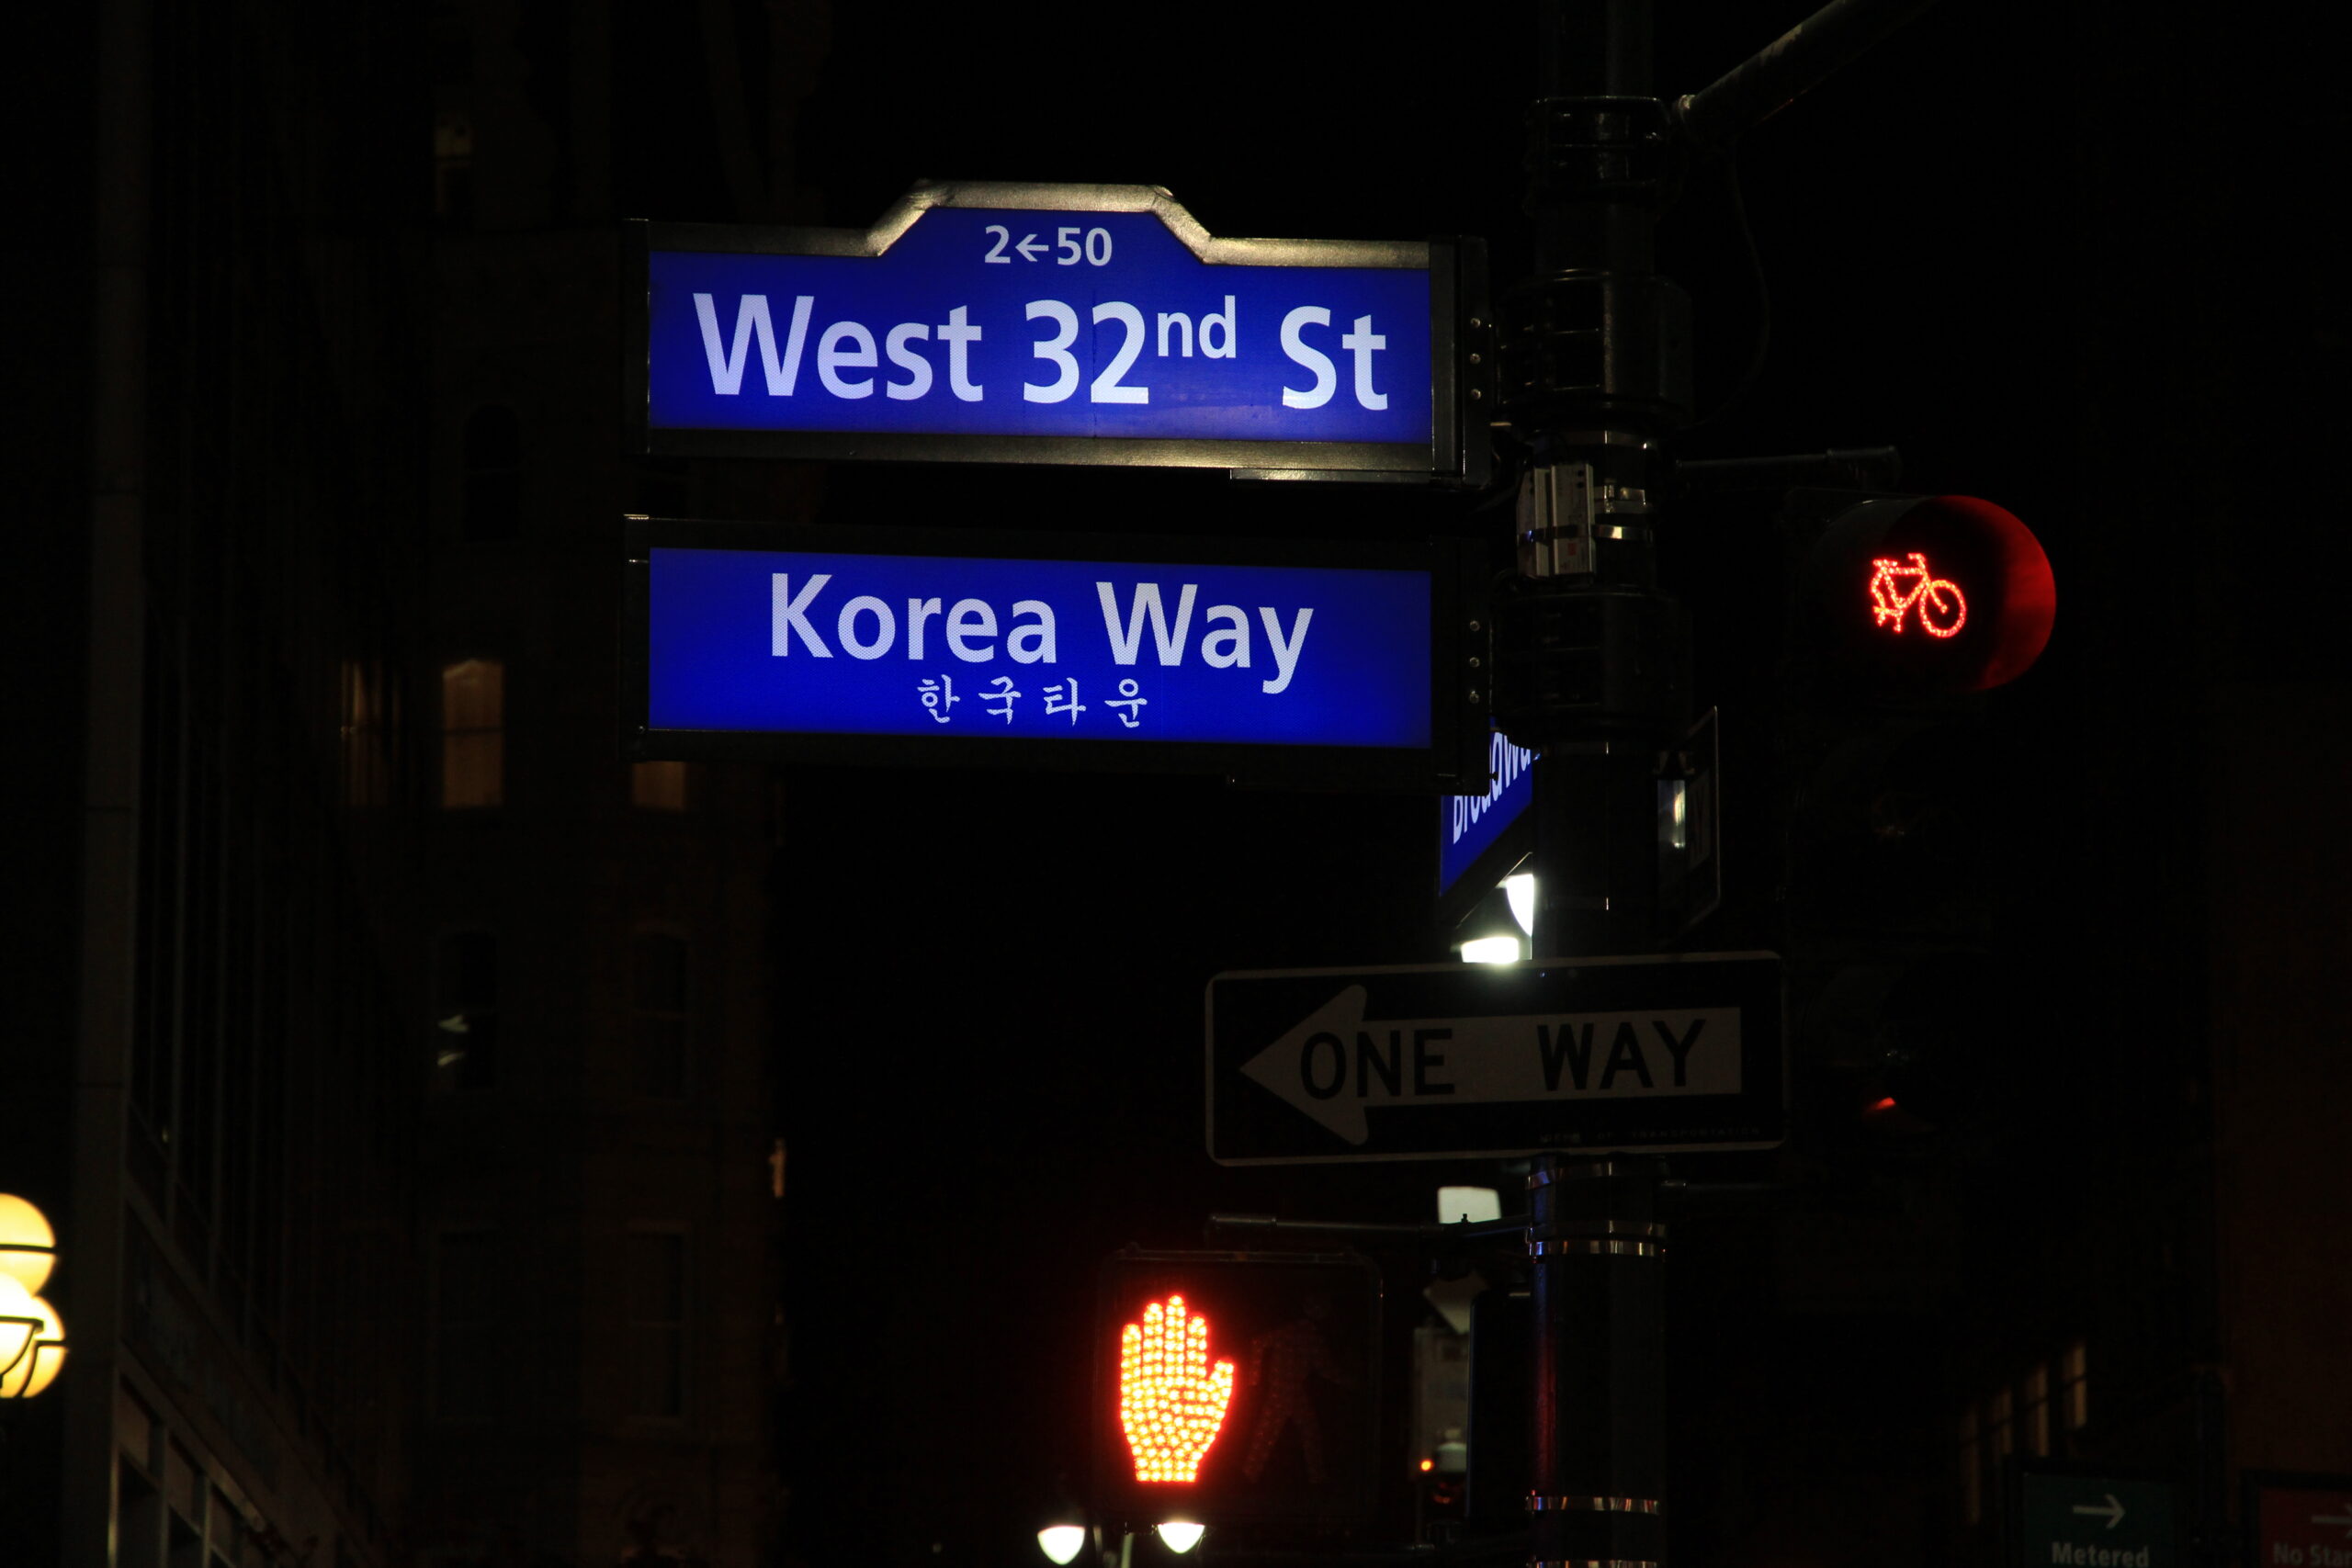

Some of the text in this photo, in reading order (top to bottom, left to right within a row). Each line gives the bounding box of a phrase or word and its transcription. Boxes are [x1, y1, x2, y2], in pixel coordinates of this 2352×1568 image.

[984, 224, 1114, 266] 2 50
[693, 293, 1389, 411] West 32nd St
[771, 572, 1314, 696] Korea Way
[1452, 731, 1533, 845] Brodw
[1299, 1019, 1707, 1100] ONE WAY
[2052, 1540, 2150, 1568] Metered
[2272, 1541, 2303, 1565] No
